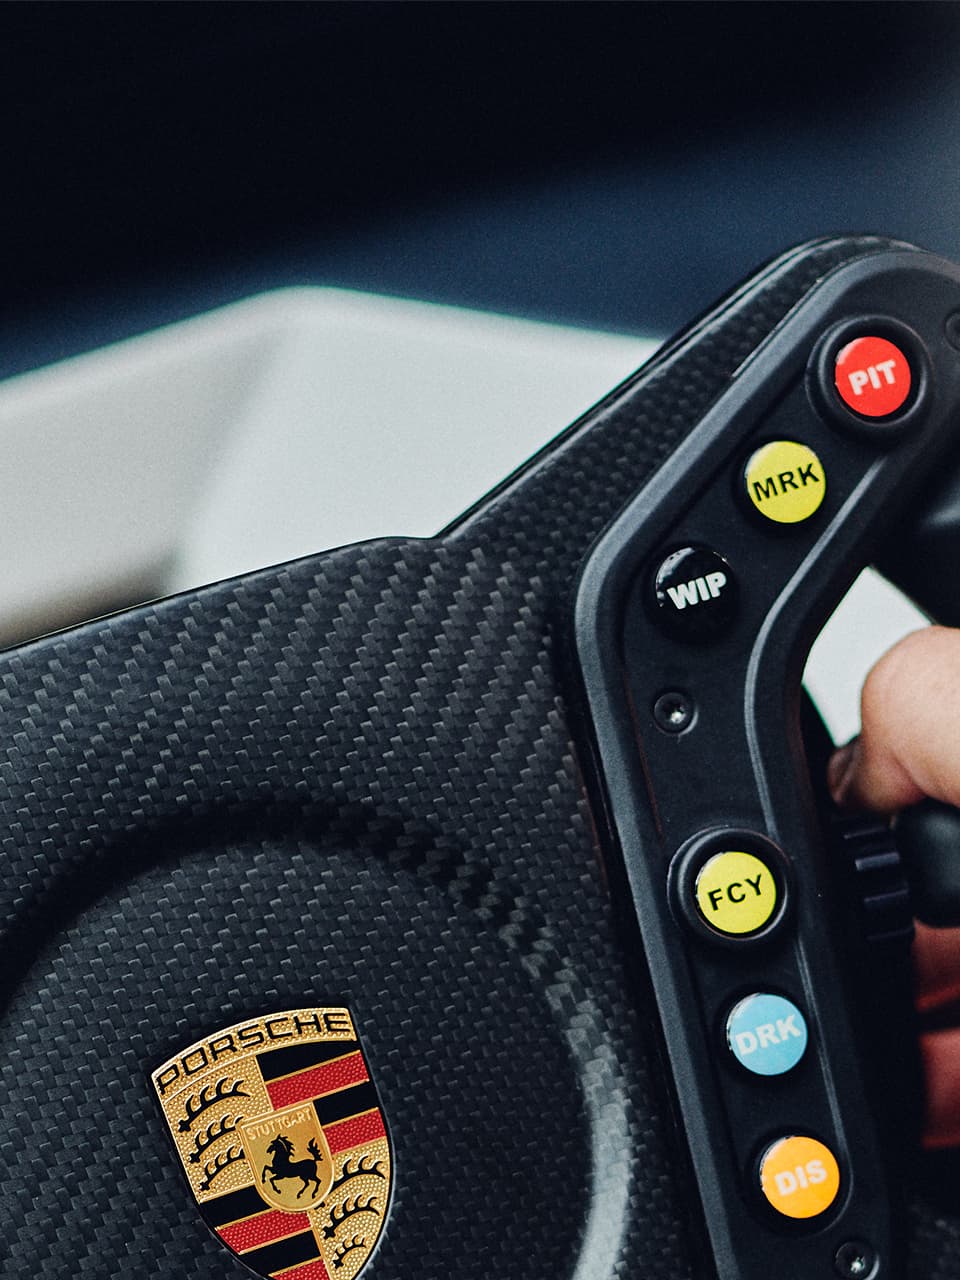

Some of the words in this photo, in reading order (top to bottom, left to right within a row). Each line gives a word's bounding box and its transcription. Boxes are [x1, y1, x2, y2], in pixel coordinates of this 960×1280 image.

[849, 360, 896, 396] PIT
[752, 463, 820, 502] MRK
[667, 571, 727, 610] WIP
[708, 875, 763, 911] FCY
[157, 1012, 351, 1095] PORSCHE
[735, 1014, 802, 1056] DRK
[246, 1107, 313, 1141] STUTTGART
[774, 1159, 828, 1196] DIS
